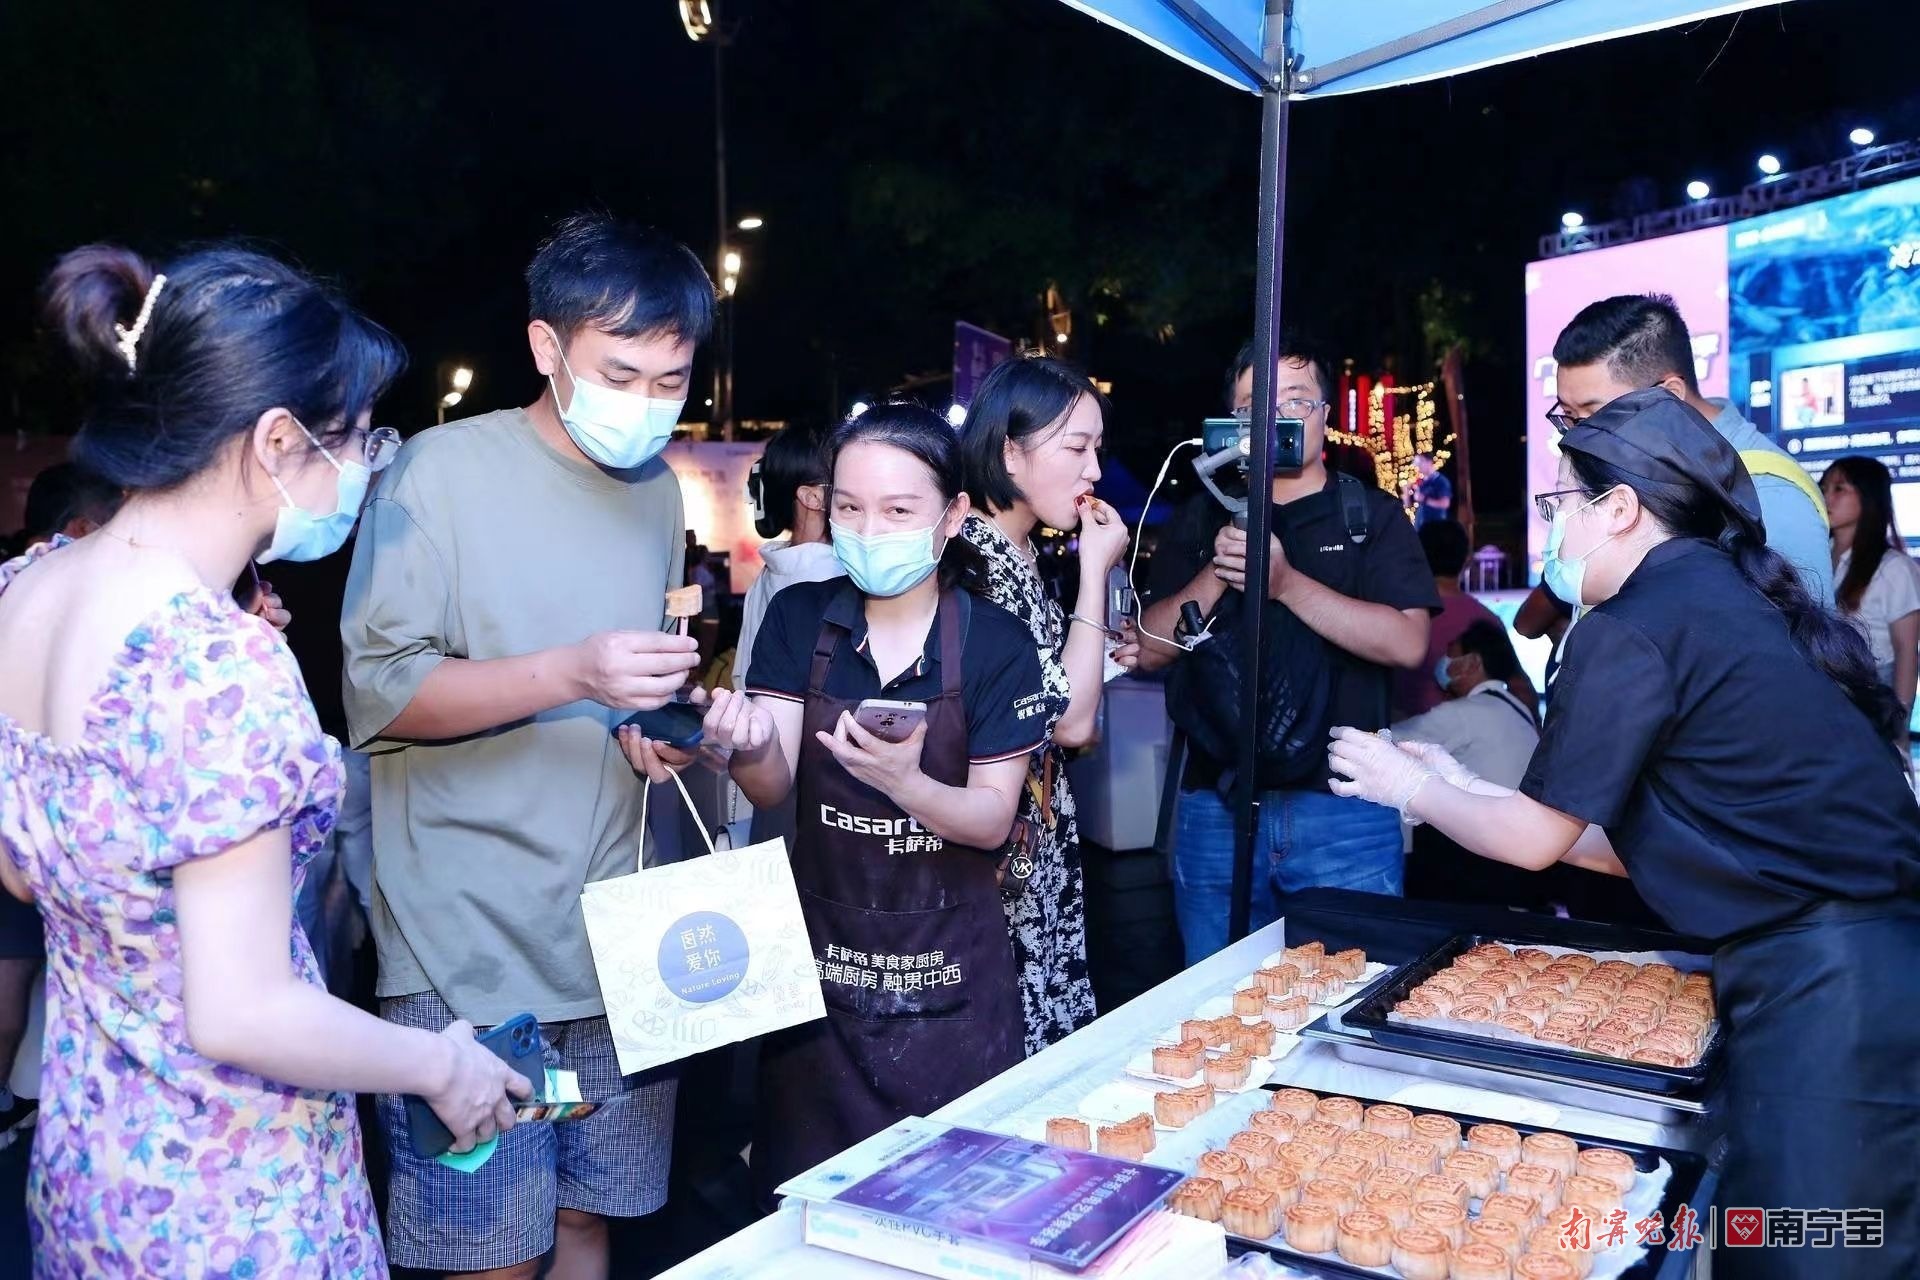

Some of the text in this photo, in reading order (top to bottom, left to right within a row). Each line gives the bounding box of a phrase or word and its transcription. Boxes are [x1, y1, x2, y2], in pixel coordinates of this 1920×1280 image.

[820, 803, 932, 836] Casart
[884, 835, 943, 855] 卡萨帝
[685, 948, 721, 975] 爱你
[824, 943, 945, 970] 卡萨帝 美食家厨房
[681, 982, 711, 995] Nature
[814, 958, 962, 992] 高端厨房 融贯中西
